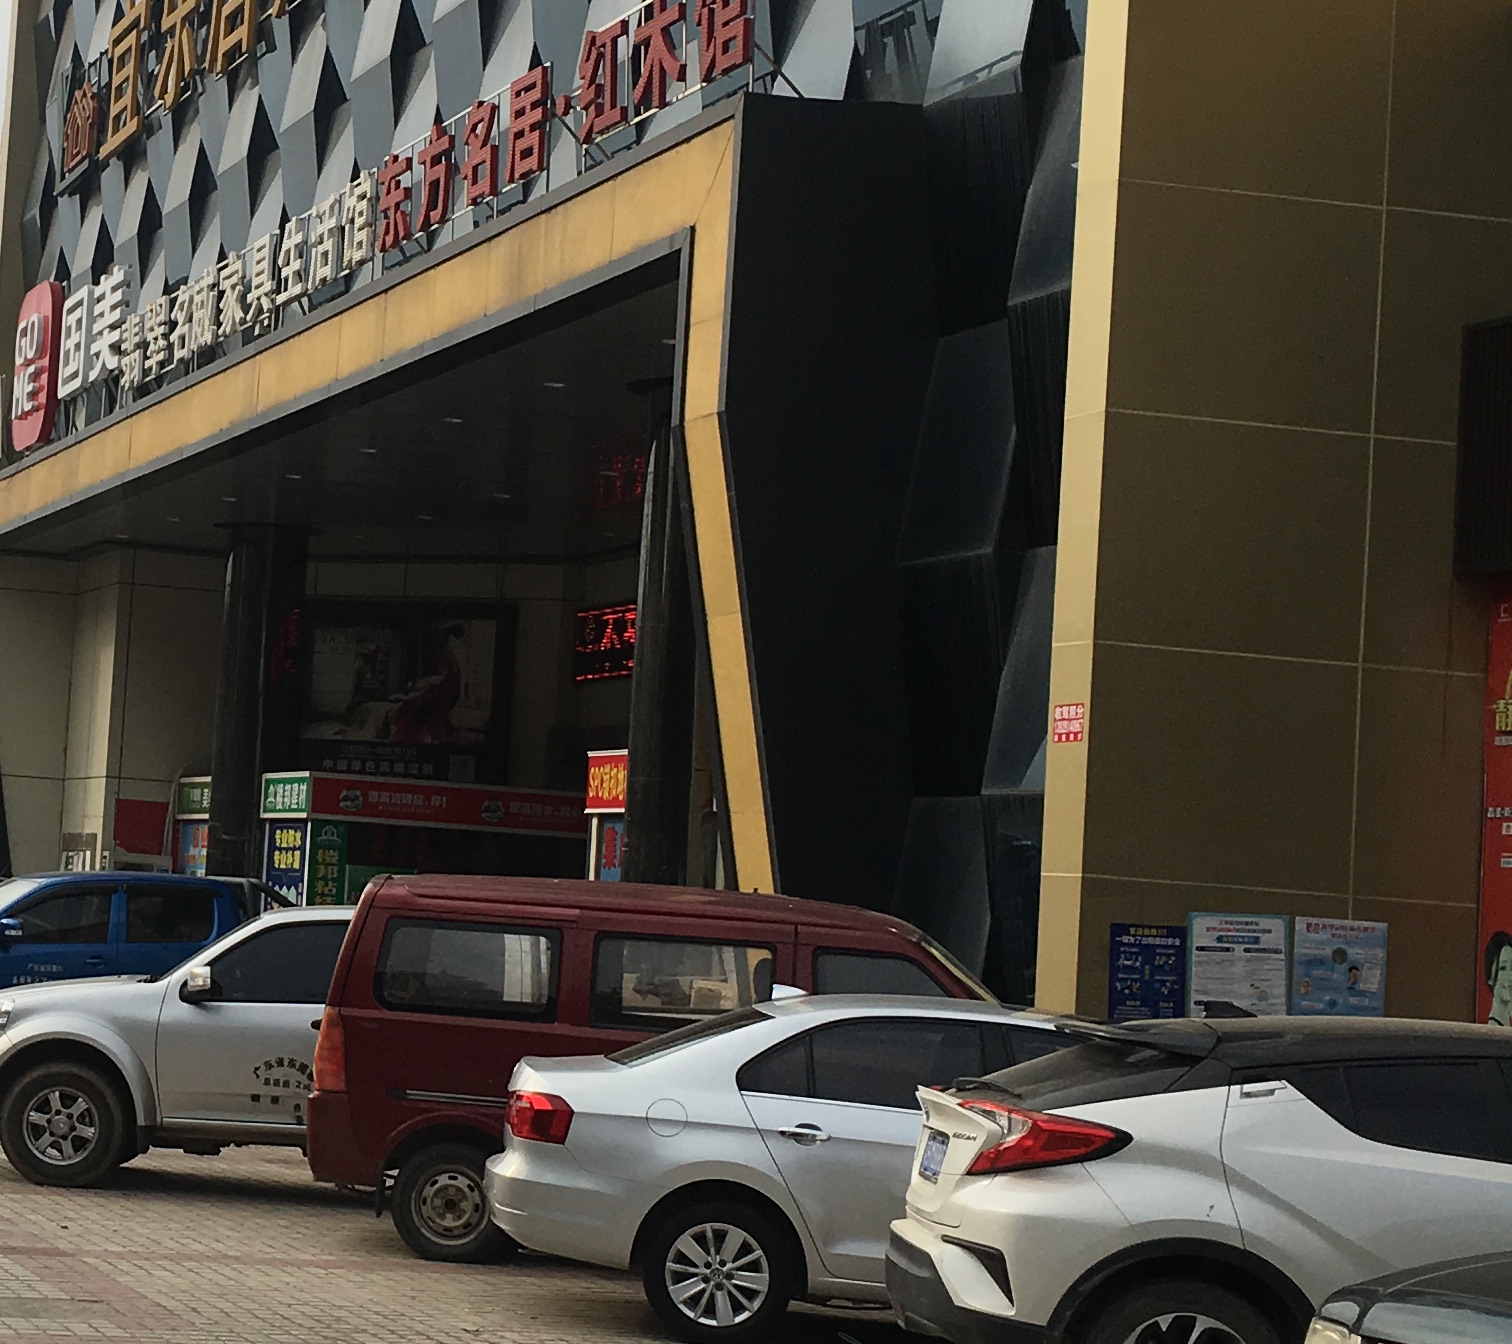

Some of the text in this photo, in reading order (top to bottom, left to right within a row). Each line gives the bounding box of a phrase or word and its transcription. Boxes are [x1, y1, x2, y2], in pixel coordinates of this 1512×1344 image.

[14, 312, 46, 368] GO
[56, 264, 132, 400] 国美
[11, 364, 42, 422] ME
